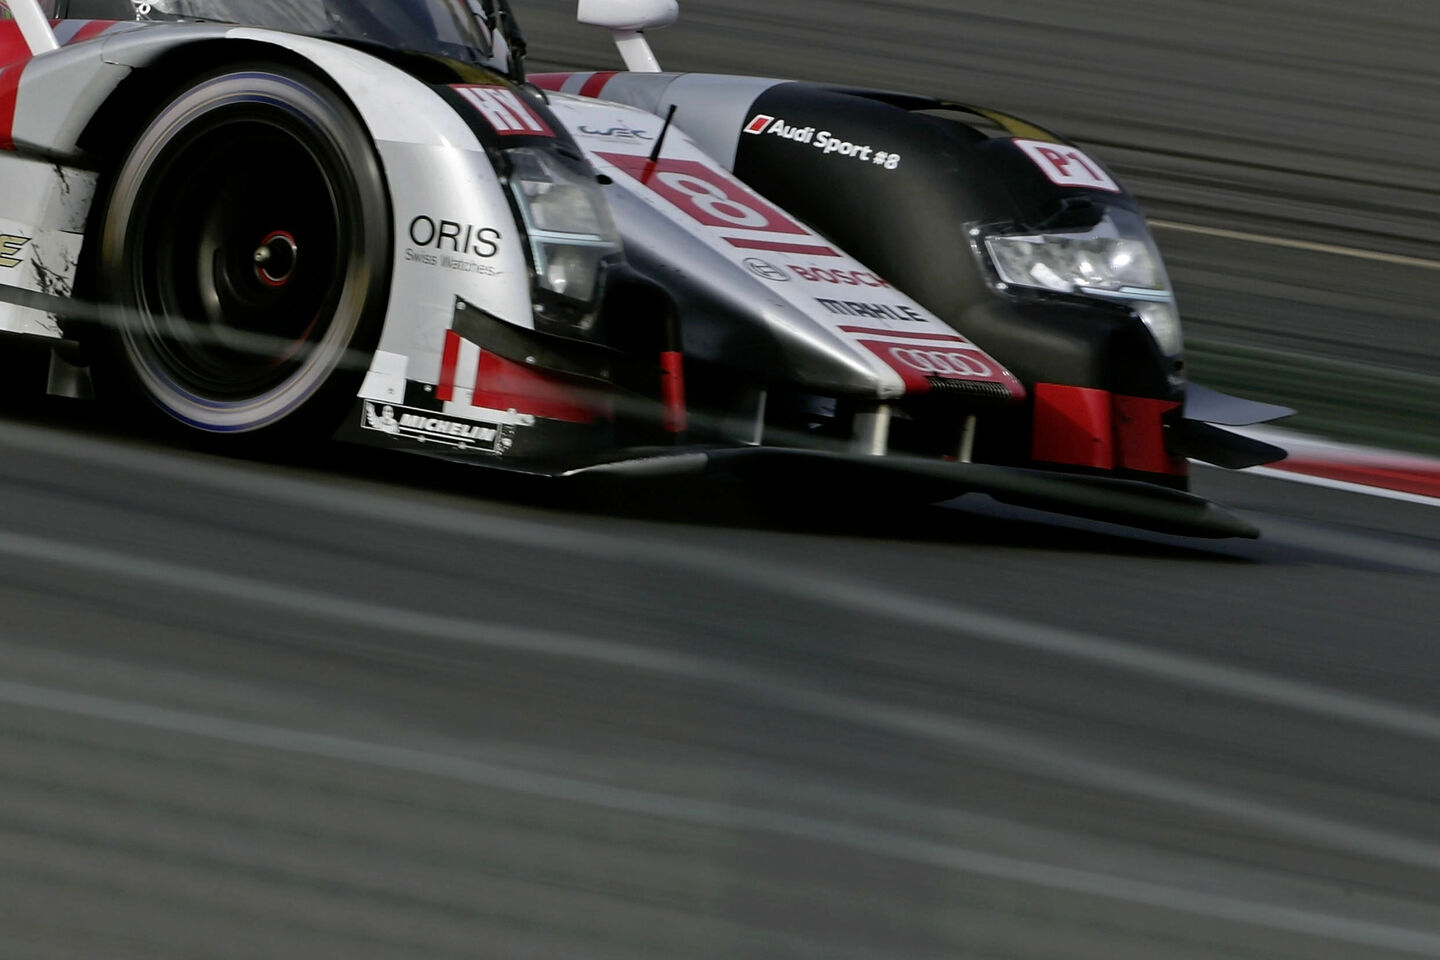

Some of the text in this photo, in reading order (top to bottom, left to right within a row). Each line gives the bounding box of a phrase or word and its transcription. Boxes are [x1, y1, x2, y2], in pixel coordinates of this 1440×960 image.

[454, 87, 545, 132] HY
[767, 119, 901, 170] Audi Sport #8
[1033, 145, 1105, 182] P1
[656, 170, 770, 228] 8
[410, 214, 502, 258] ORIS
[405, 247, 496, 276] Swiss Watches
[814, 297, 931, 323] MAHLE
[399, 413, 497, 442] MICHELIN
